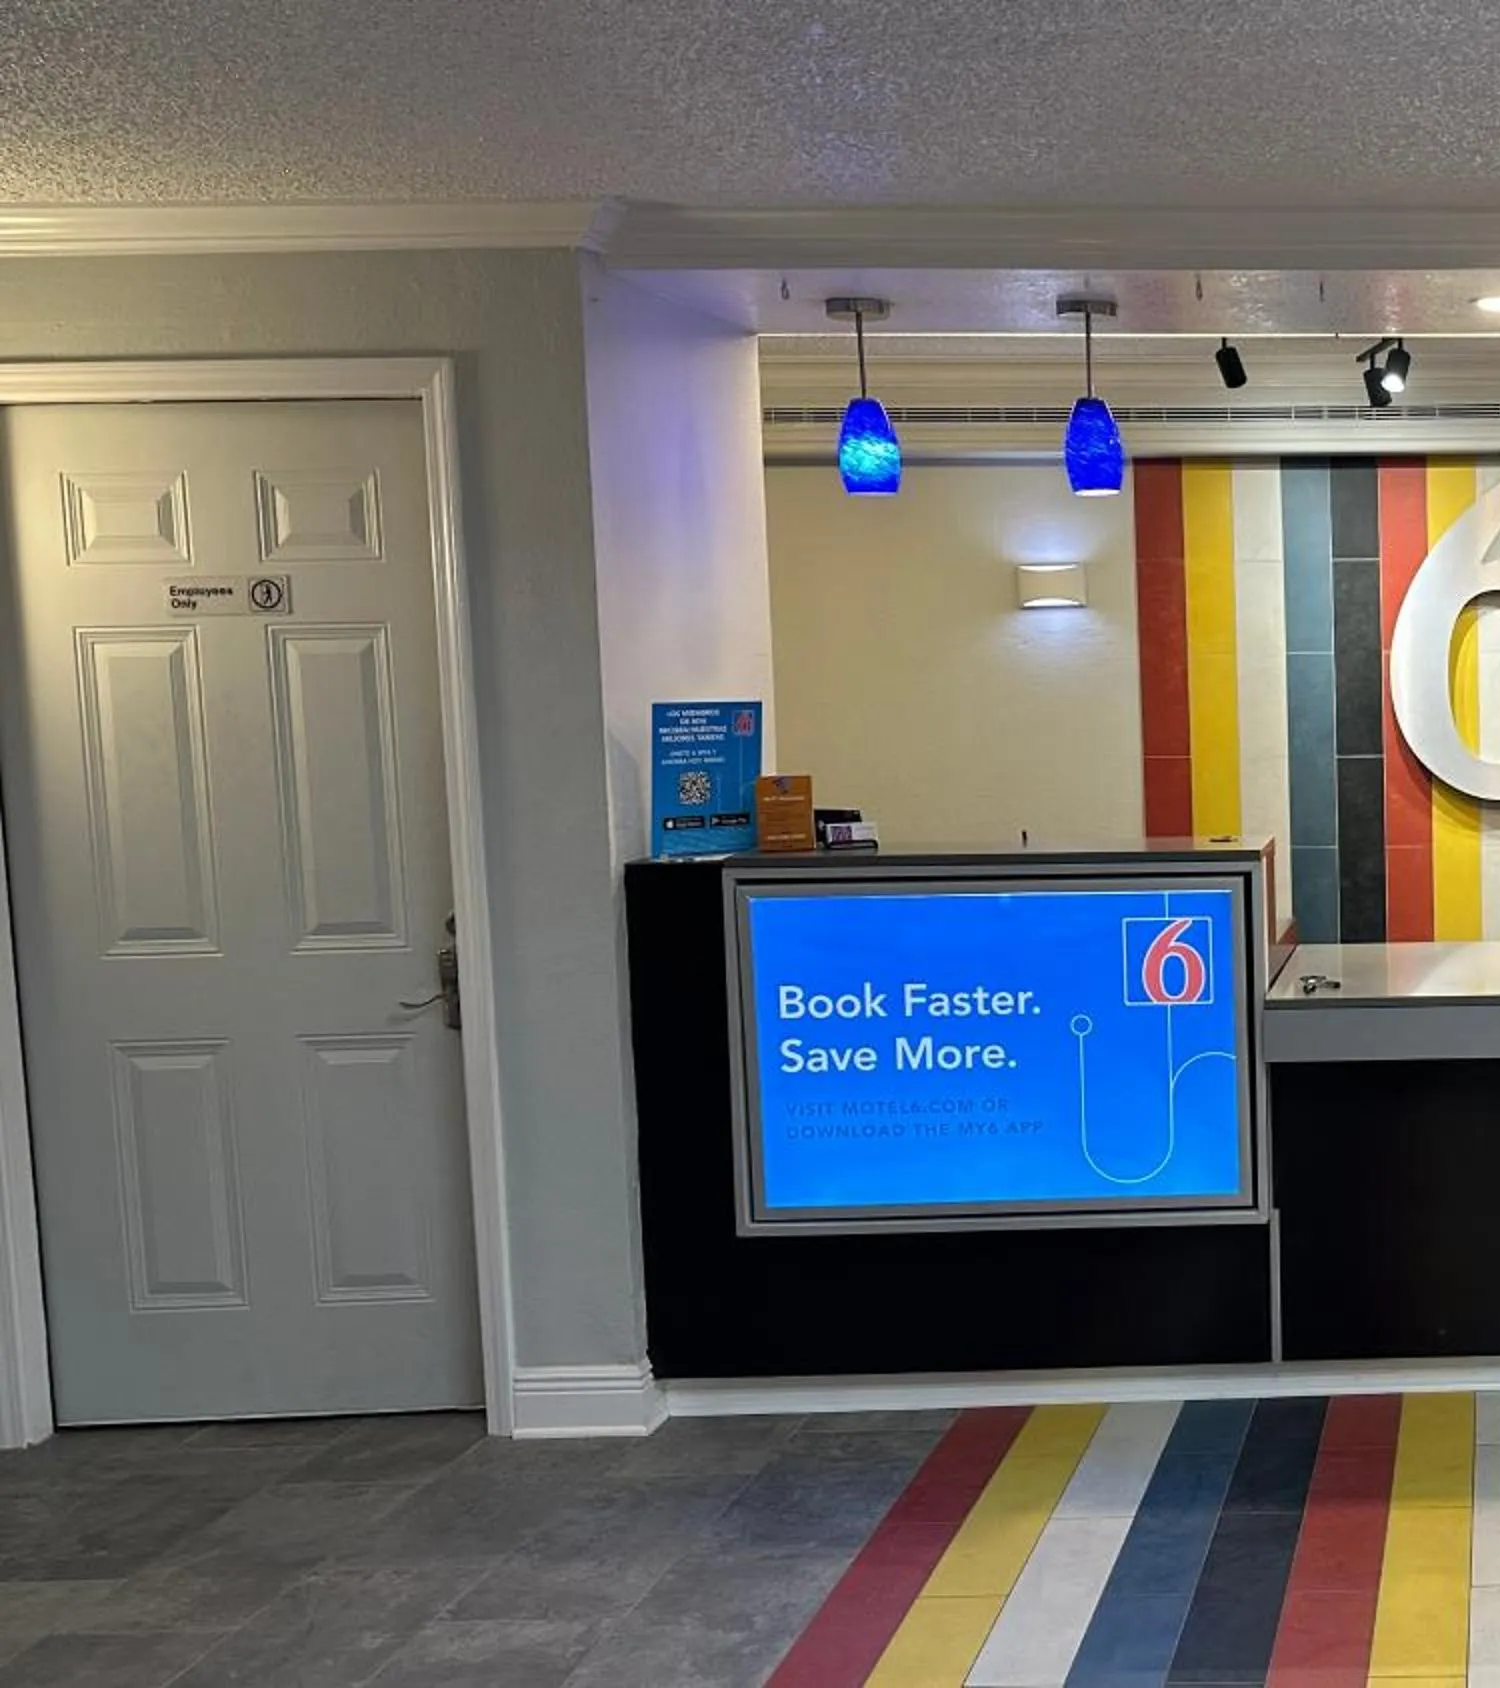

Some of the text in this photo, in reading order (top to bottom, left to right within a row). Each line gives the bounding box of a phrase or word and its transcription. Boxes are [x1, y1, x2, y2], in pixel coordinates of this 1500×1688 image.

[169, 585, 234, 598] Employees
[171, 598, 197, 610] Only
[1142, 917, 1206, 1005] 6
[779, 982, 1041, 1020] Book Faster.
[780, 1036, 1017, 1073] Save More.
[784, 1098, 1009, 1118] VISIT MOTEL6.COM OR
[786, 1121, 1044, 1140] DOWNLOAD THE MY6 APP
